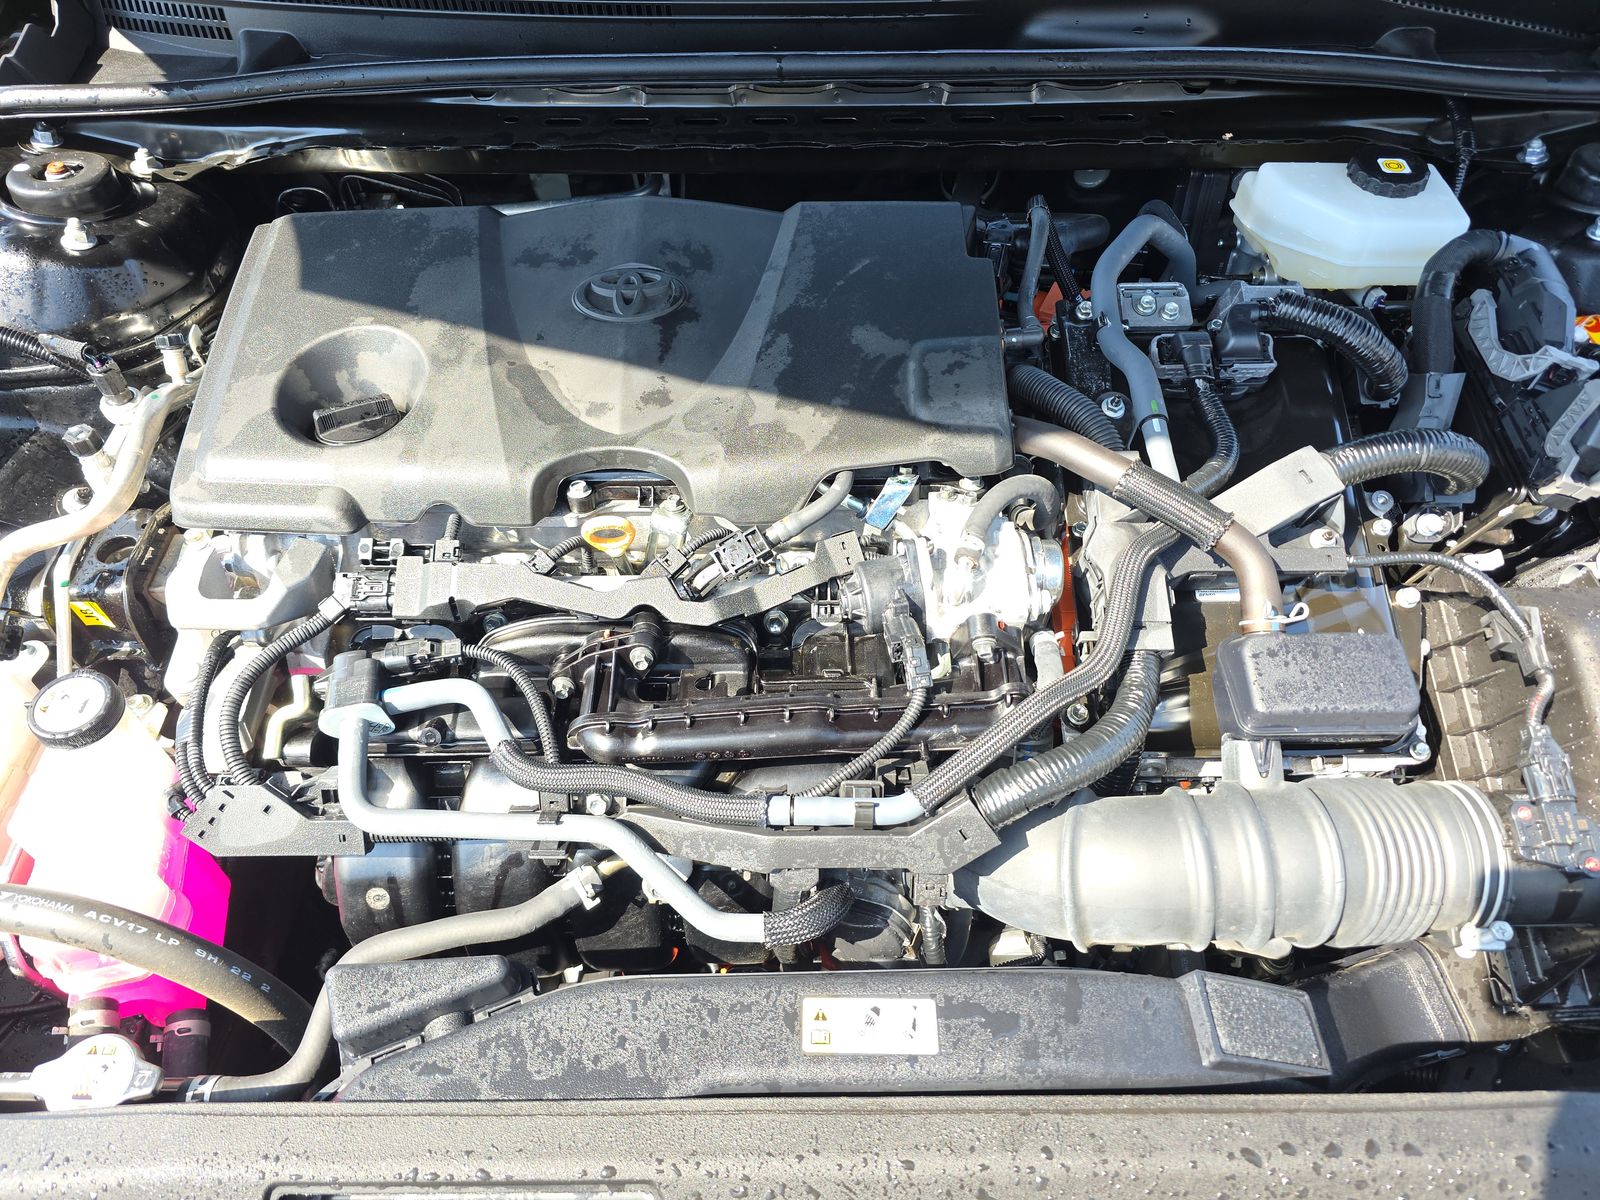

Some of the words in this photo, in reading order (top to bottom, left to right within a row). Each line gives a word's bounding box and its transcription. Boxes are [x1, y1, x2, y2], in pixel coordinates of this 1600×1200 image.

[13, 893, 75, 914] YOKOHAMA
[83, 909, 149, 934] ACV17
[155, 932, 180, 946] LP
[229, 965, 252, 982] 22
[260, 983, 271, 993] 2
